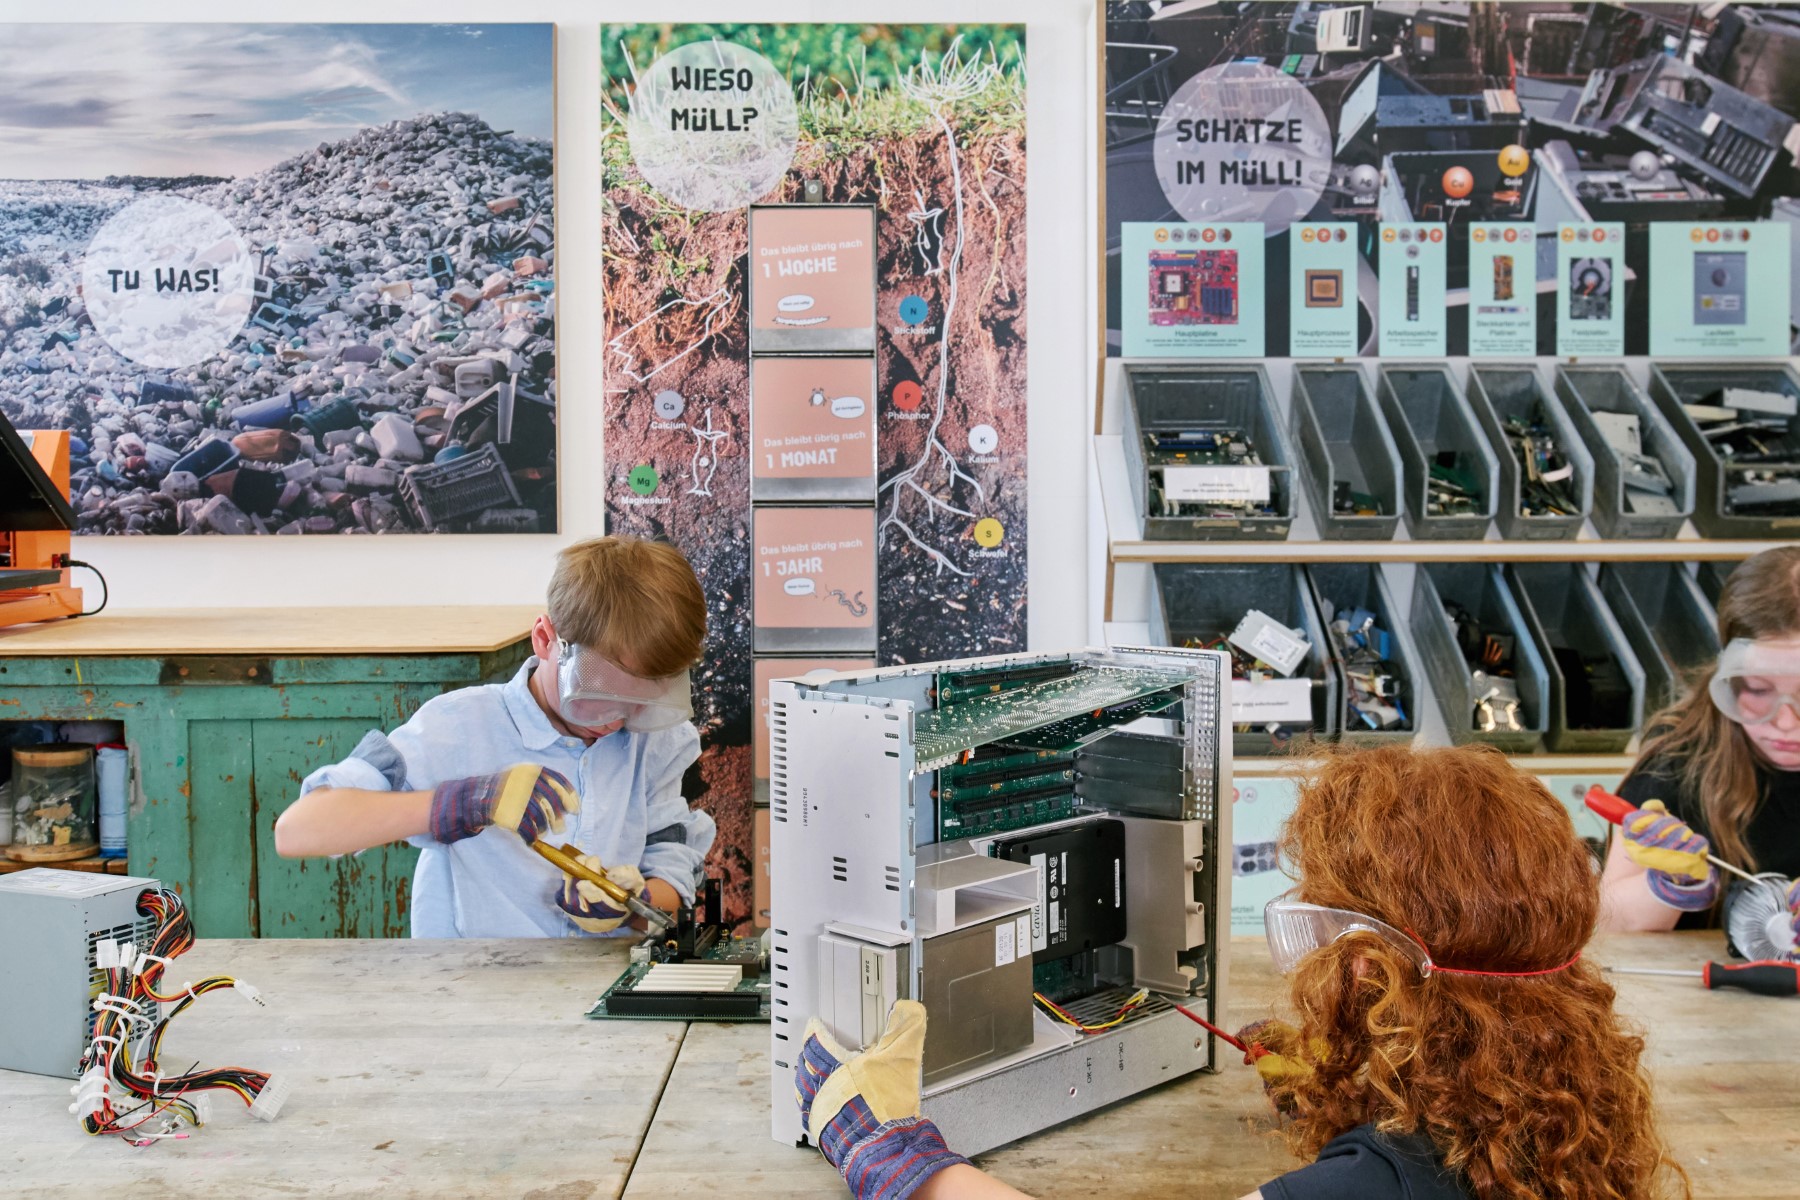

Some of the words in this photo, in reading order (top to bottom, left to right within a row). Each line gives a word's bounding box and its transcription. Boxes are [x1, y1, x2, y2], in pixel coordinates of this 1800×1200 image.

[671, 66, 753, 91] WIESO
[671, 107, 758, 131] MÜLL?
[1177, 118, 1302, 143] SCHÄTZE
[1507, 158, 1520, 166] Au
[1177, 160, 1205, 184] IM
[1220, 160, 1302, 185] MÜLL!
[1451, 180, 1465, 188] Cu
[1504, 178, 1523, 186] Gold
[1353, 196, 1375, 205] Silber
[1445, 198, 1471, 207] Kupfer
[760, 247, 779, 256] Das
[784, 243, 810, 254] bleibt
[811, 241, 837, 252] übrig
[839, 239, 863, 249] nach
[762, 263, 770, 278] 1
[778, 256, 837, 278] WOCHE
[107, 269, 140, 293] TU
[155, 267, 219, 293] WAS!
[909, 307, 918, 315] N
[894, 326, 936, 335] Stickstoff
[1175, 330, 1218, 338] Hauptplatine
[1297, 330, 1351, 338] Hauptprozessor
[904, 392, 911, 400] P
[663, 402, 675, 411] Ca
[888, 411, 931, 421] Phosphor
[651, 421, 687, 430] Calcium
[764, 437, 782, 447] Das
[785, 435, 812, 446] bleibt
[814, 433, 840, 444] übrig
[842, 430, 866, 440] nach
[979, 437, 987, 445] K
[765, 453, 774, 469] 1
[781, 447, 837, 468] MONAT
[968, 455, 999, 464] Kalium
[637, 477, 650, 487] Mg
[621, 496, 671, 506] Magnesium
[985, 530, 992, 538] S
[760, 546, 779, 556] Das
[782, 543, 809, 554] bleibt
[811, 541, 837, 552] übrig
[839, 539, 863, 548] nach
[968, 549, 1008, 558] Schwefel
[762, 561, 771, 577] 1
[776, 557, 823, 576] JAHR
